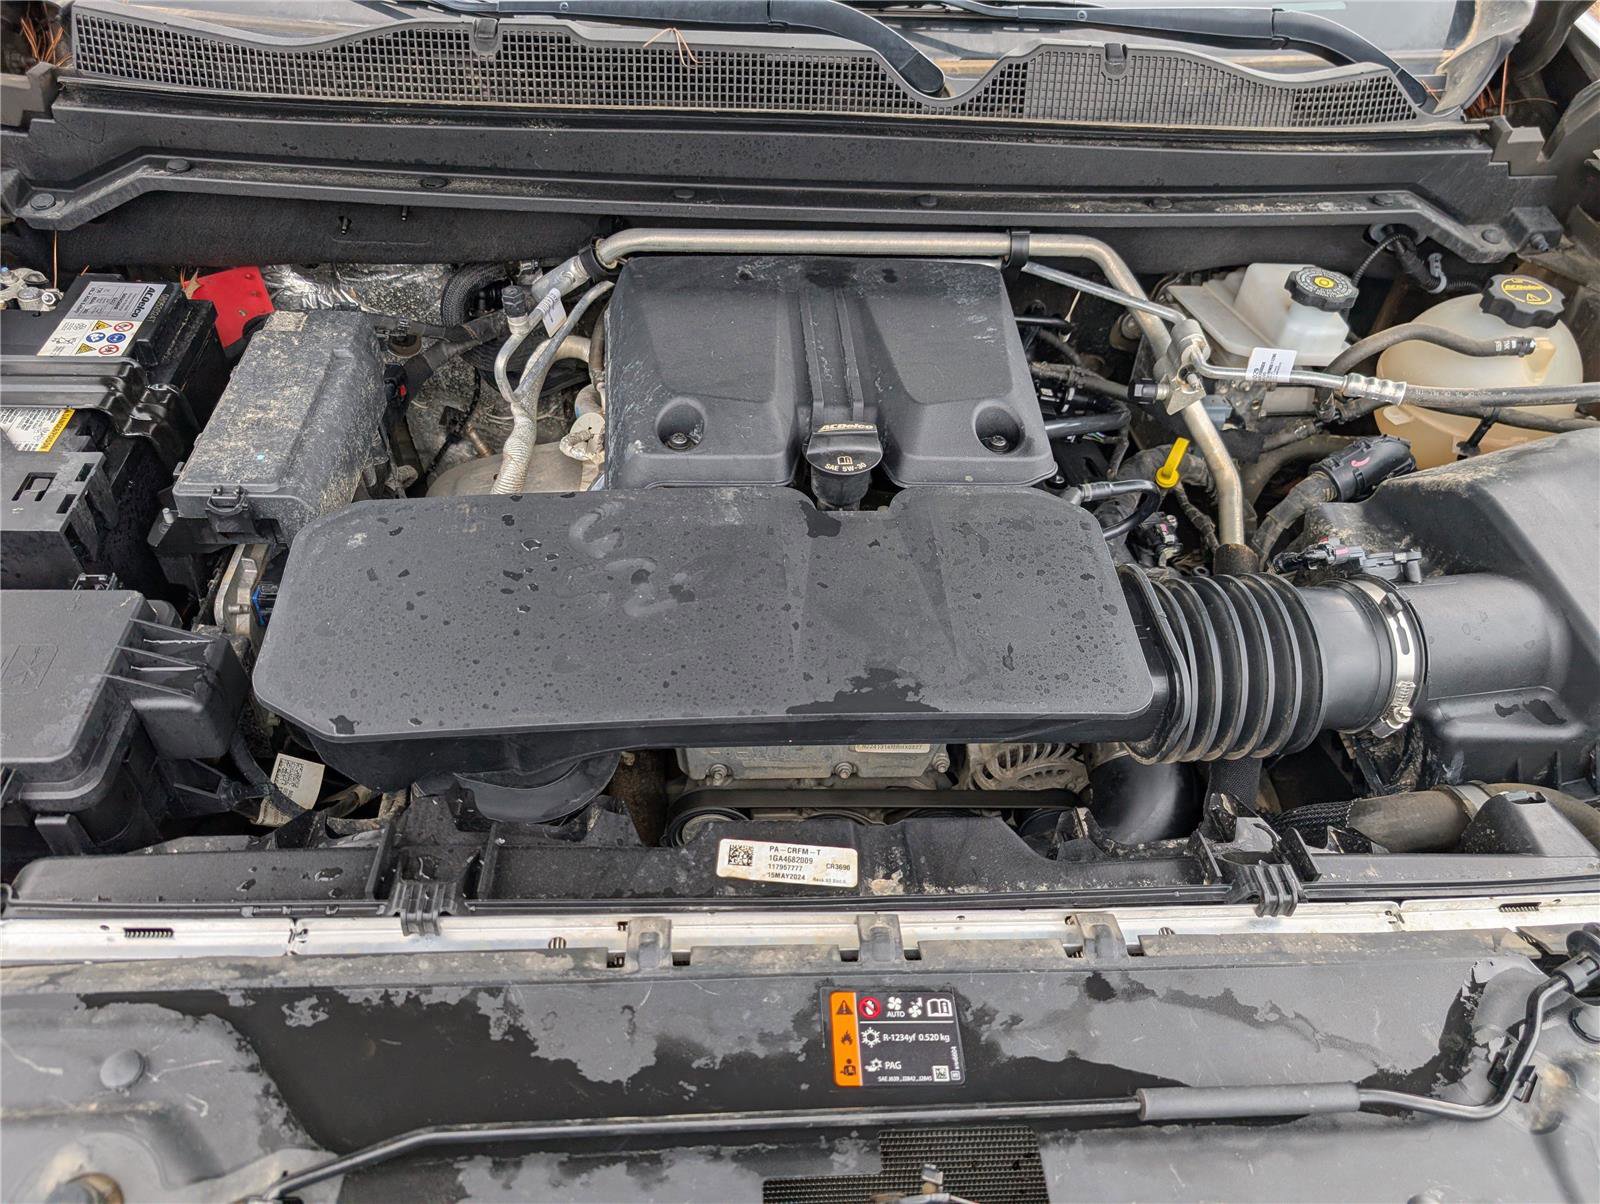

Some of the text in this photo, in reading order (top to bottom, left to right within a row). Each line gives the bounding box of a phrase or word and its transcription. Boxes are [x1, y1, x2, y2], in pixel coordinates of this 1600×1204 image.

[131, 286, 156, 318] ACDelco
[819, 423, 874, 432] ACDelco
[824, 462, 867, 472] SAE 5W-30
[767, 872, 806, 881] 15MAY2024
[886, 1010, 906, 1018] AUTO
[883, 1033, 951, 1044] R-1234yf 0.520 kg
[884, 1060, 902, 1070] PAG
